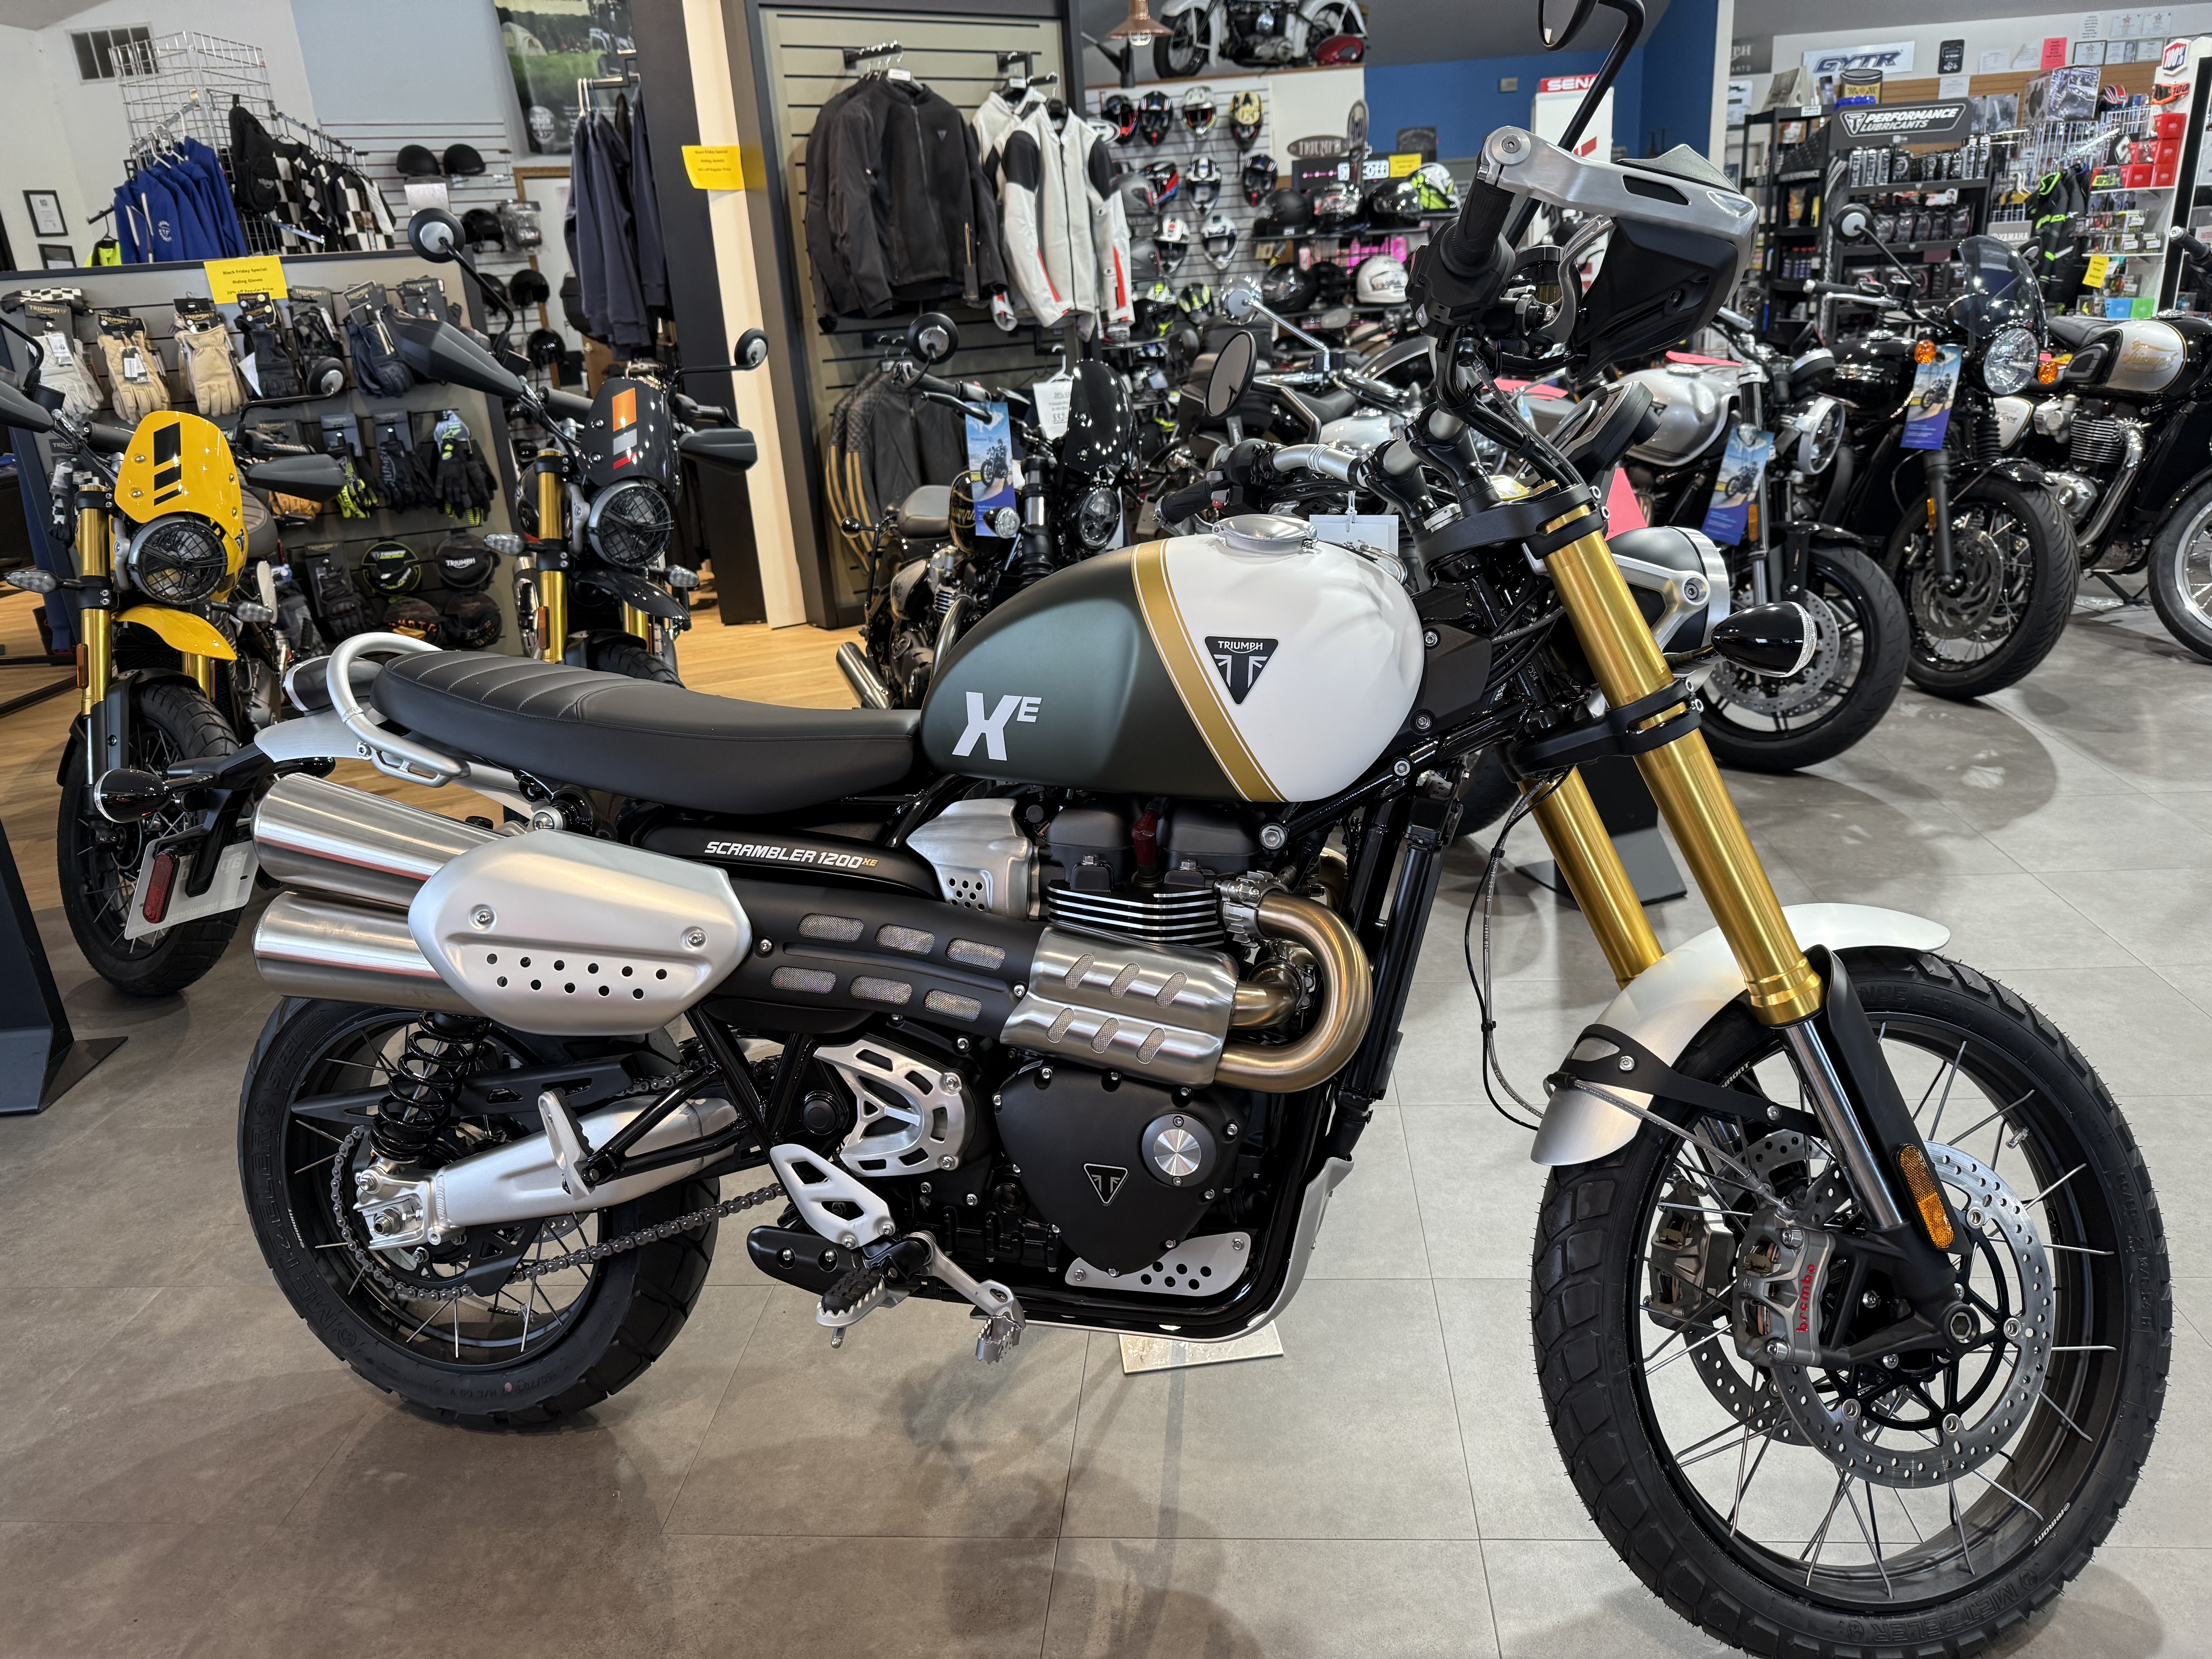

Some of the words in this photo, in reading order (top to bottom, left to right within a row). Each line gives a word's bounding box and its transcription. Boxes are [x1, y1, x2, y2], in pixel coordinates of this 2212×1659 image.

[2164, 46, 2186, 68] 100%
[1865, 108, 1960, 124] PERFORMANCE
[1860, 119, 1930, 132] LUBRICANTS
[29, 305, 60, 314] TRIUMPH
[101, 315, 127, 324] TRIUMPH
[445, 557, 476, 569] TRIUMPH
[1218, 641, 1263, 654] TRIUMPH
[704, 842, 817, 863] SCRAMBLER
[1721, 1061, 1750, 1088] HRONT
[250, 1127, 339, 1331] METZELER
[1795, 1263, 1816, 1333] brembo
[1870, 1582, 2018, 1642] METZELER
